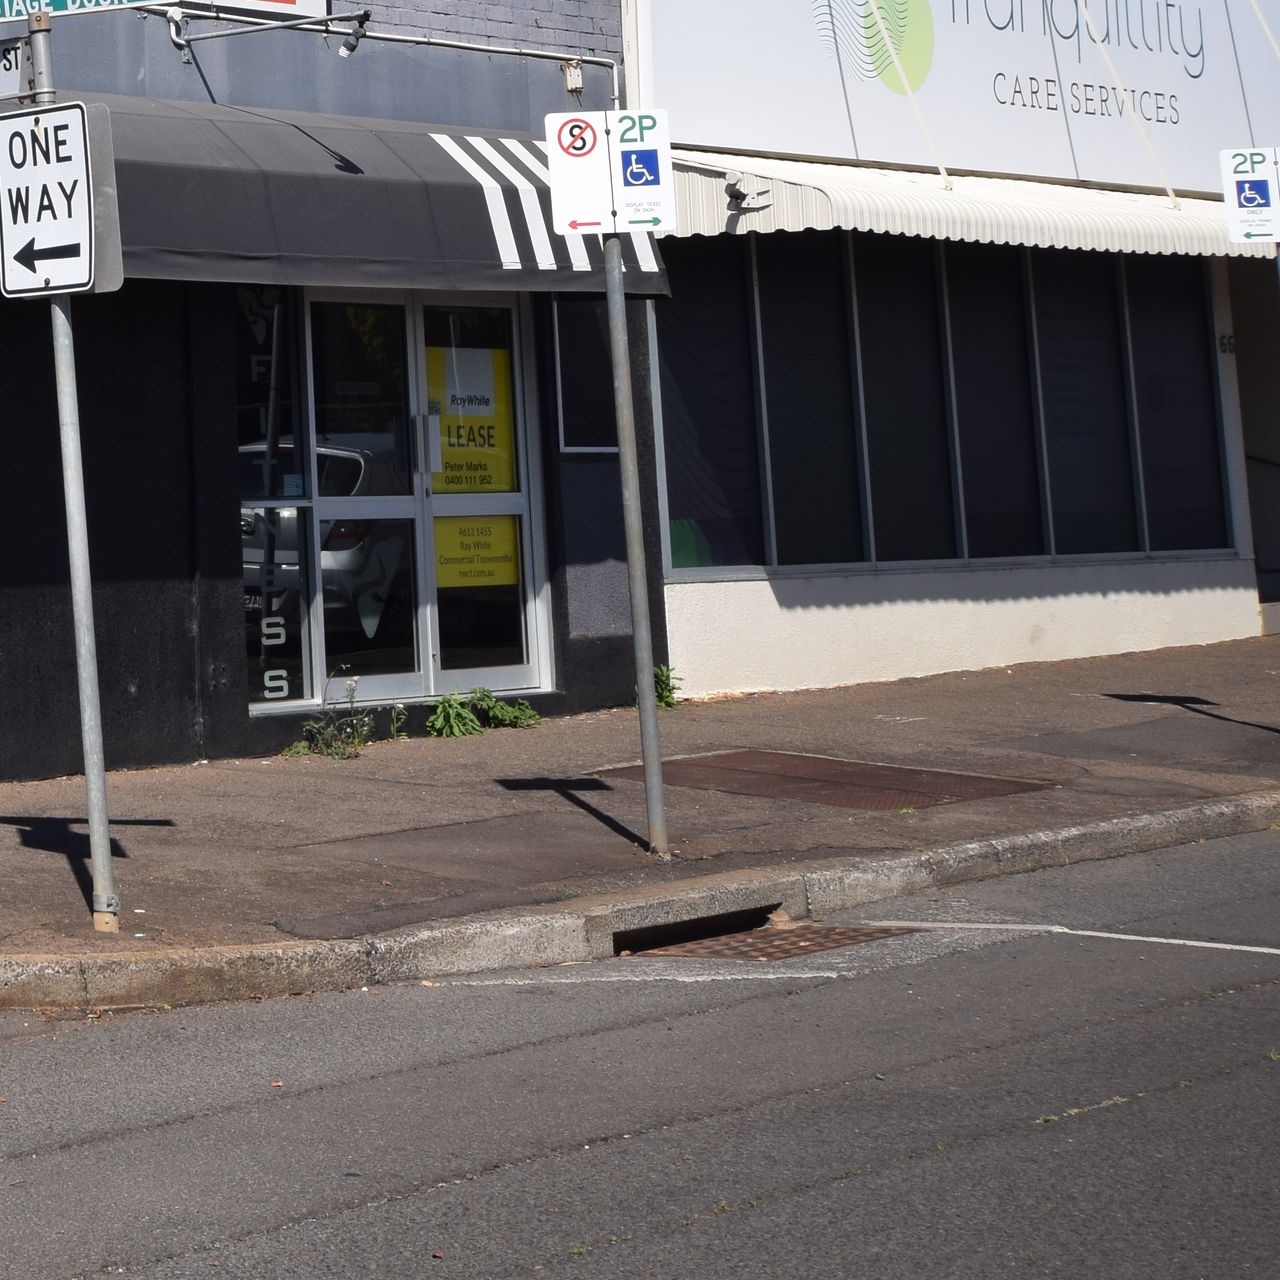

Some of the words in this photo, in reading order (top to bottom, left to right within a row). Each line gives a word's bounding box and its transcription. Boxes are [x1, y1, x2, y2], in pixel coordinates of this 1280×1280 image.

[2, 47, 20, 72] ST
[992, 72, 1058, 112] CARE
[1070, 82, 1180, 126] SERVICES
[618, 114, 658, 144] 2P
[8, 123, 73, 170] ONE
[1230, 151, 1267, 175] 2P
[7, 179, 79, 226] WAY
[447, 425, 496, 448] LEASE
[444, 461, 464, 472] Peter
[465, 461, 488, 472] Marks
[445, 475, 463, 485] 0400
[465, 475, 477, 485] 111
[479, 474, 493, 485] 952
[458, 527, 475, 537] 4613
[460, 540, 472, 552] Ray
[473, 540, 492, 550] White
[439, 554, 475, 565] Commercial
[476, 553, 513, 564] Toowoomba
